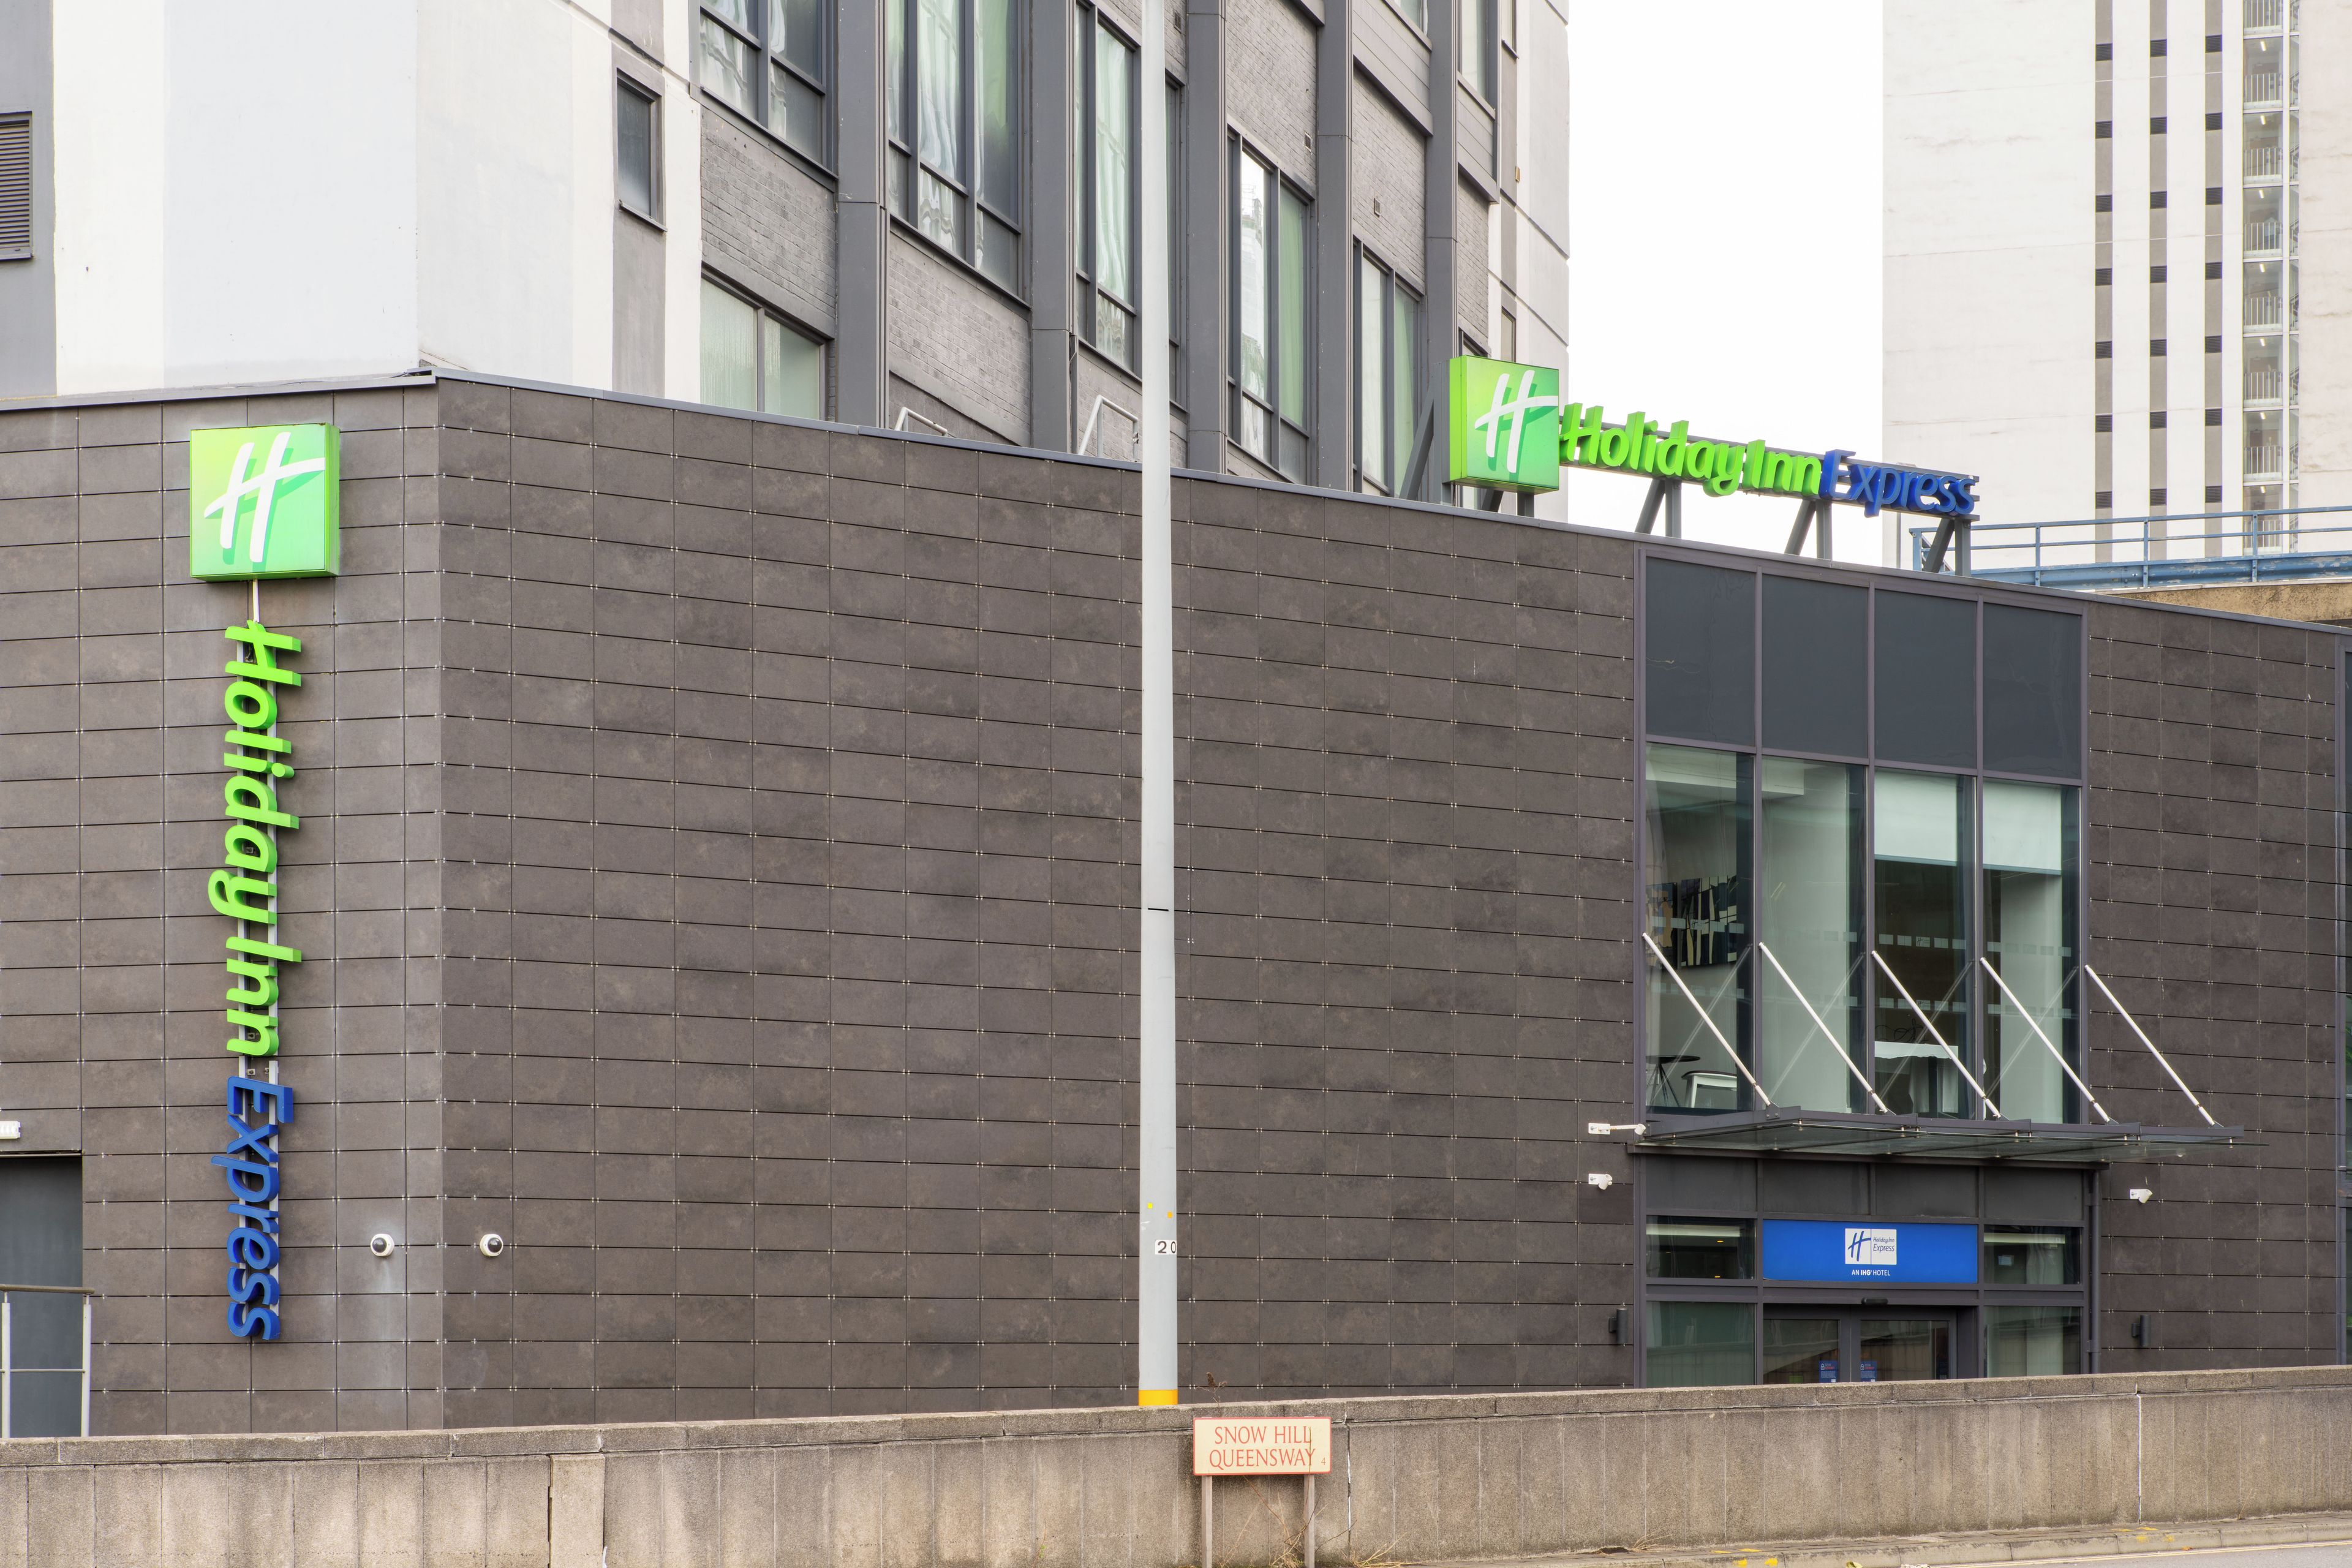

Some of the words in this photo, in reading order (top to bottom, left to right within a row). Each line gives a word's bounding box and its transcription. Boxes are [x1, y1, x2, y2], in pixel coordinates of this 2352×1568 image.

[1820, 448, 1975, 518] Express
[211, 1076, 293, 1341] Express
[1157, 1240, 1177, 1254] 20
[1873, 1244, 1895, 1253] Express
[1215, 1426, 1267, 1444] SNOW
[1275, 1426, 1312, 1444] HILL
[1209, 1448, 1316, 1470] QUEENSWAY
[1321, 1457, 1327, 1466] 4
